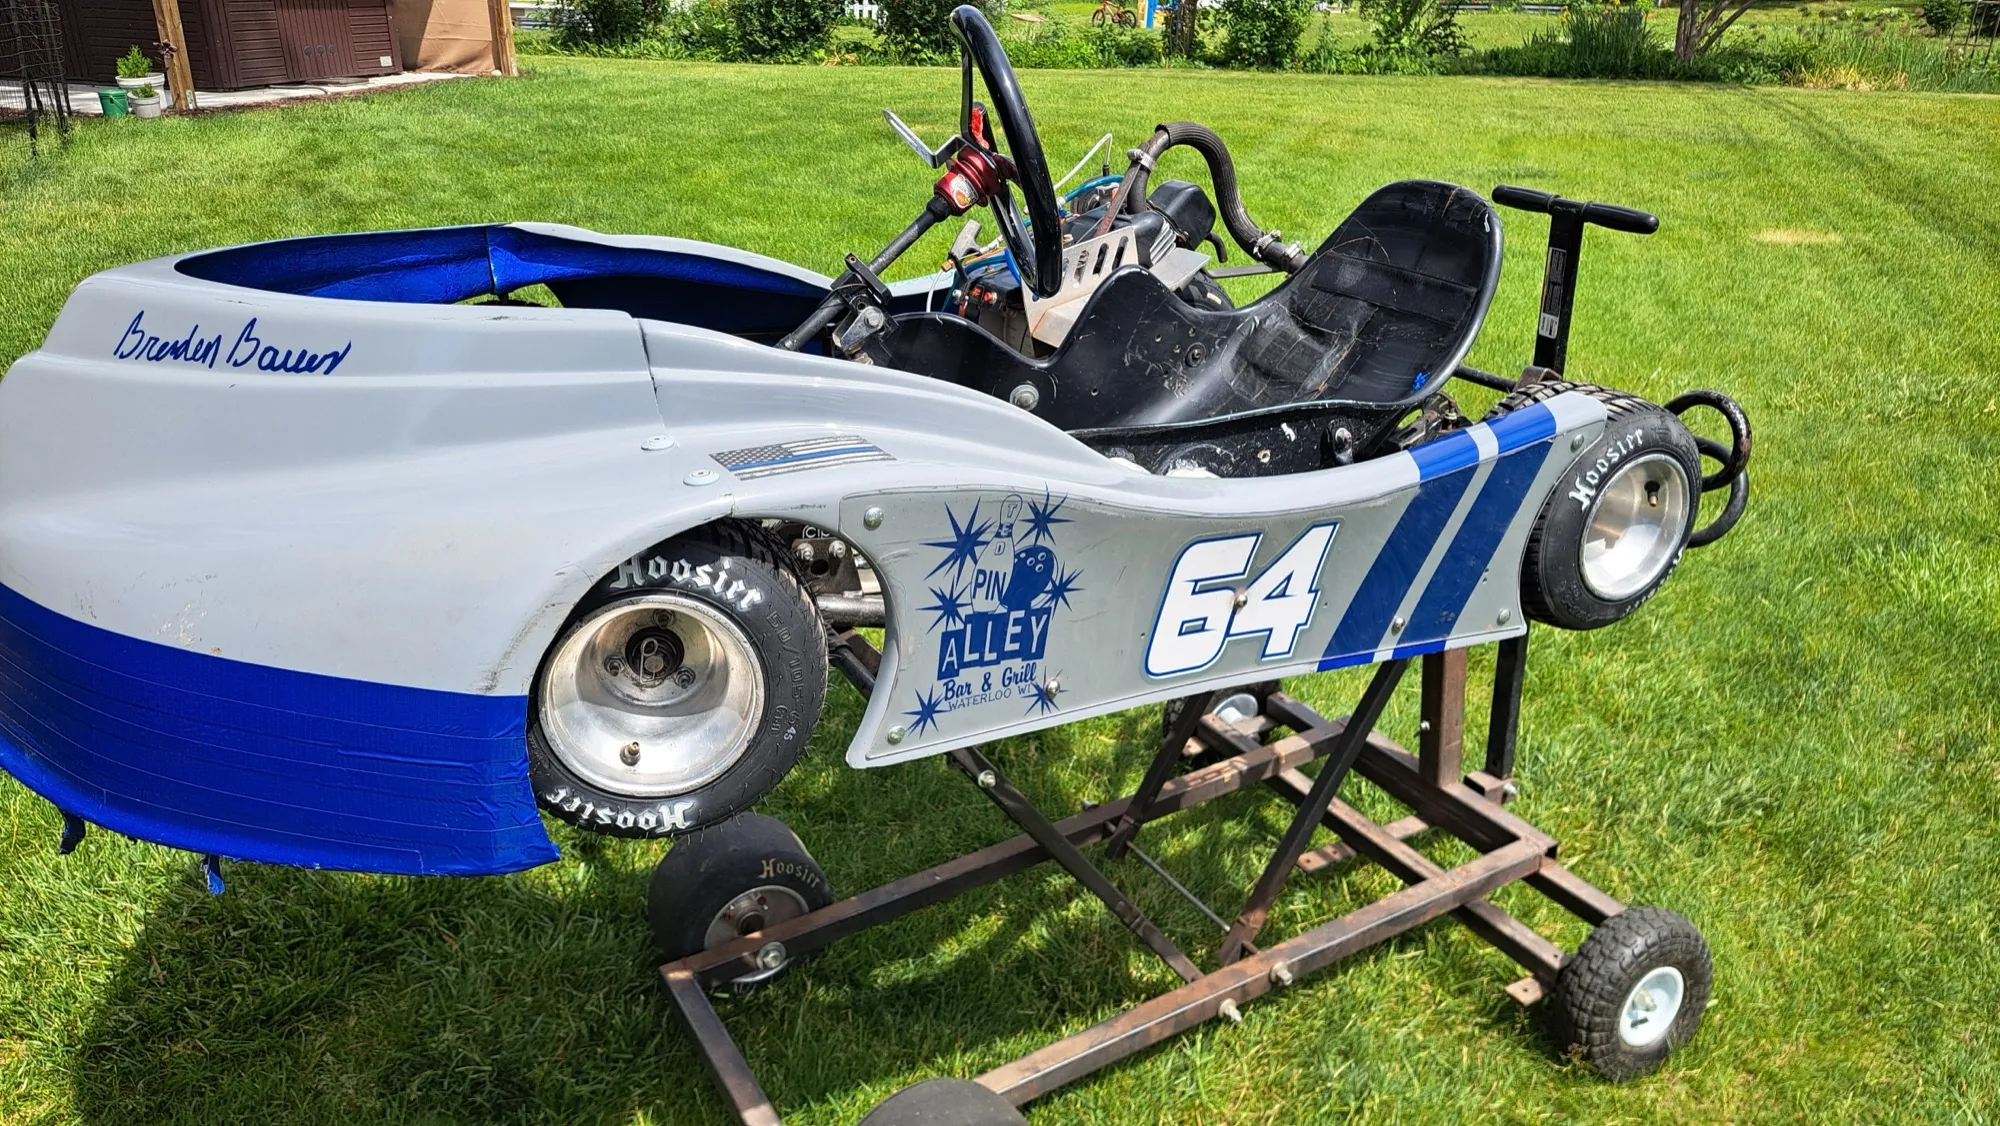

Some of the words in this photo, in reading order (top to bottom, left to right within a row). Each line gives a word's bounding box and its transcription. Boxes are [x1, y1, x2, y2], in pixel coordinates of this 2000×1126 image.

[1568, 428, 1643, 511] Hoosier
[609, 554, 763, 610] Hoosier
[972, 568, 1007, 602] PIN
[1144, 521, 1341, 680] 64
[940, 609, 1049, 674] ALLEY
[943, 679, 972, 701] Bar
[981, 671, 992, 693] &
[1002, 662, 1037, 688] Grill
[948, 687, 1012, 711] WATERLOO
[1017, 683, 1031, 695] WI
[545, 787, 695, 834] Hoosier
[757, 858, 821, 888] Hoosier
